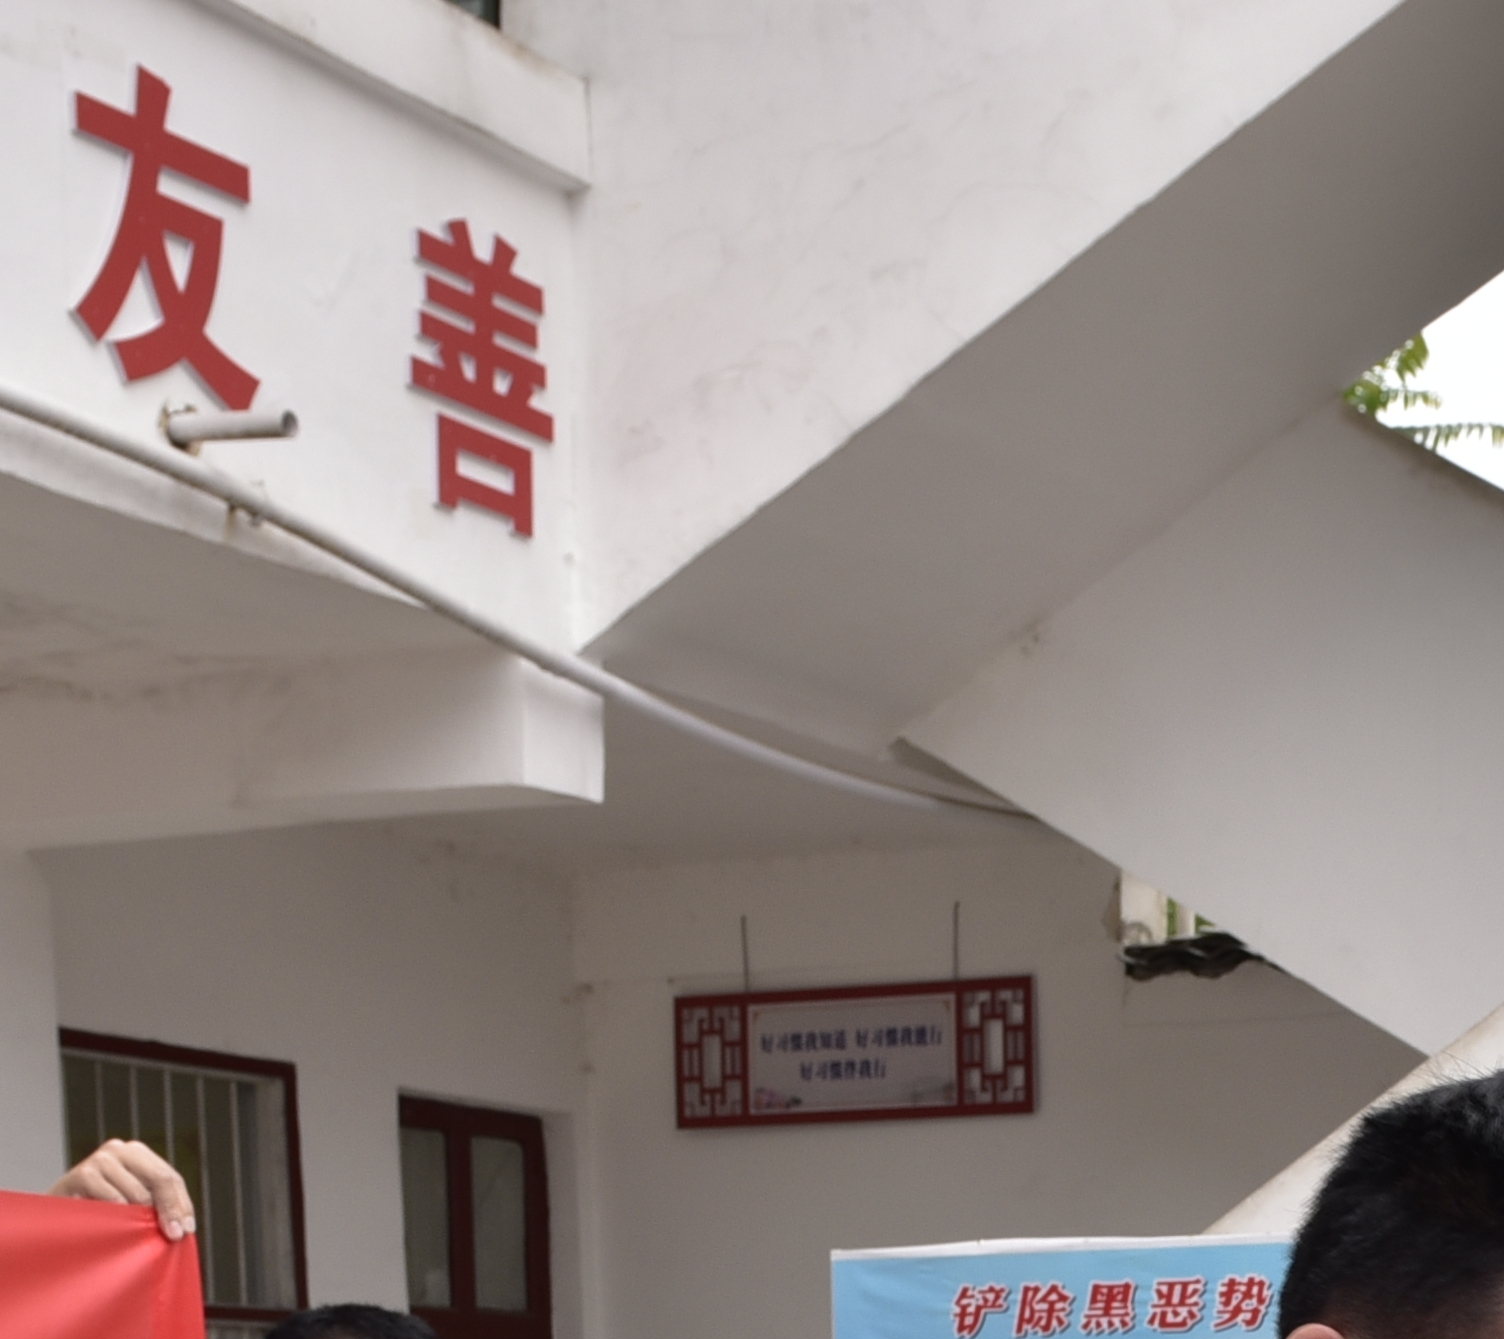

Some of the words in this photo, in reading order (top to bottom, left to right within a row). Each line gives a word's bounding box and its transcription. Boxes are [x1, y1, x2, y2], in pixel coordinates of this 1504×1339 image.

[951, 1276, 1273, 1338] 铲除黑恶势
